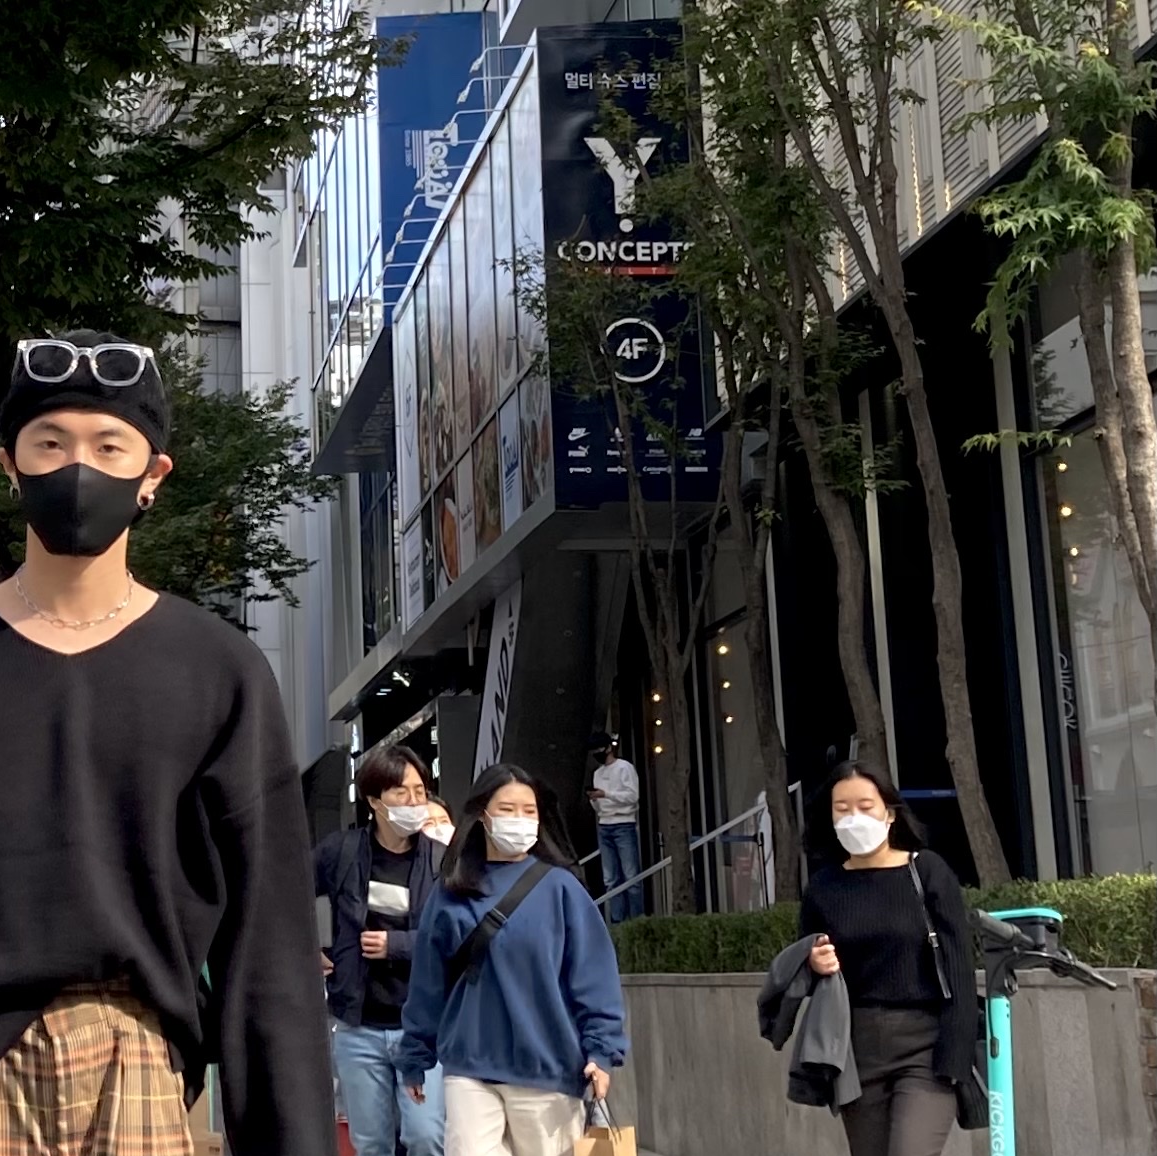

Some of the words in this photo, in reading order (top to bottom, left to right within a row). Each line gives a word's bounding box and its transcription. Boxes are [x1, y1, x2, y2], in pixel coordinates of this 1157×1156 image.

[565, 72, 593, 90] 멀티
[631, 72, 662, 90] 편집
[616, 338, 648, 361] 4F
